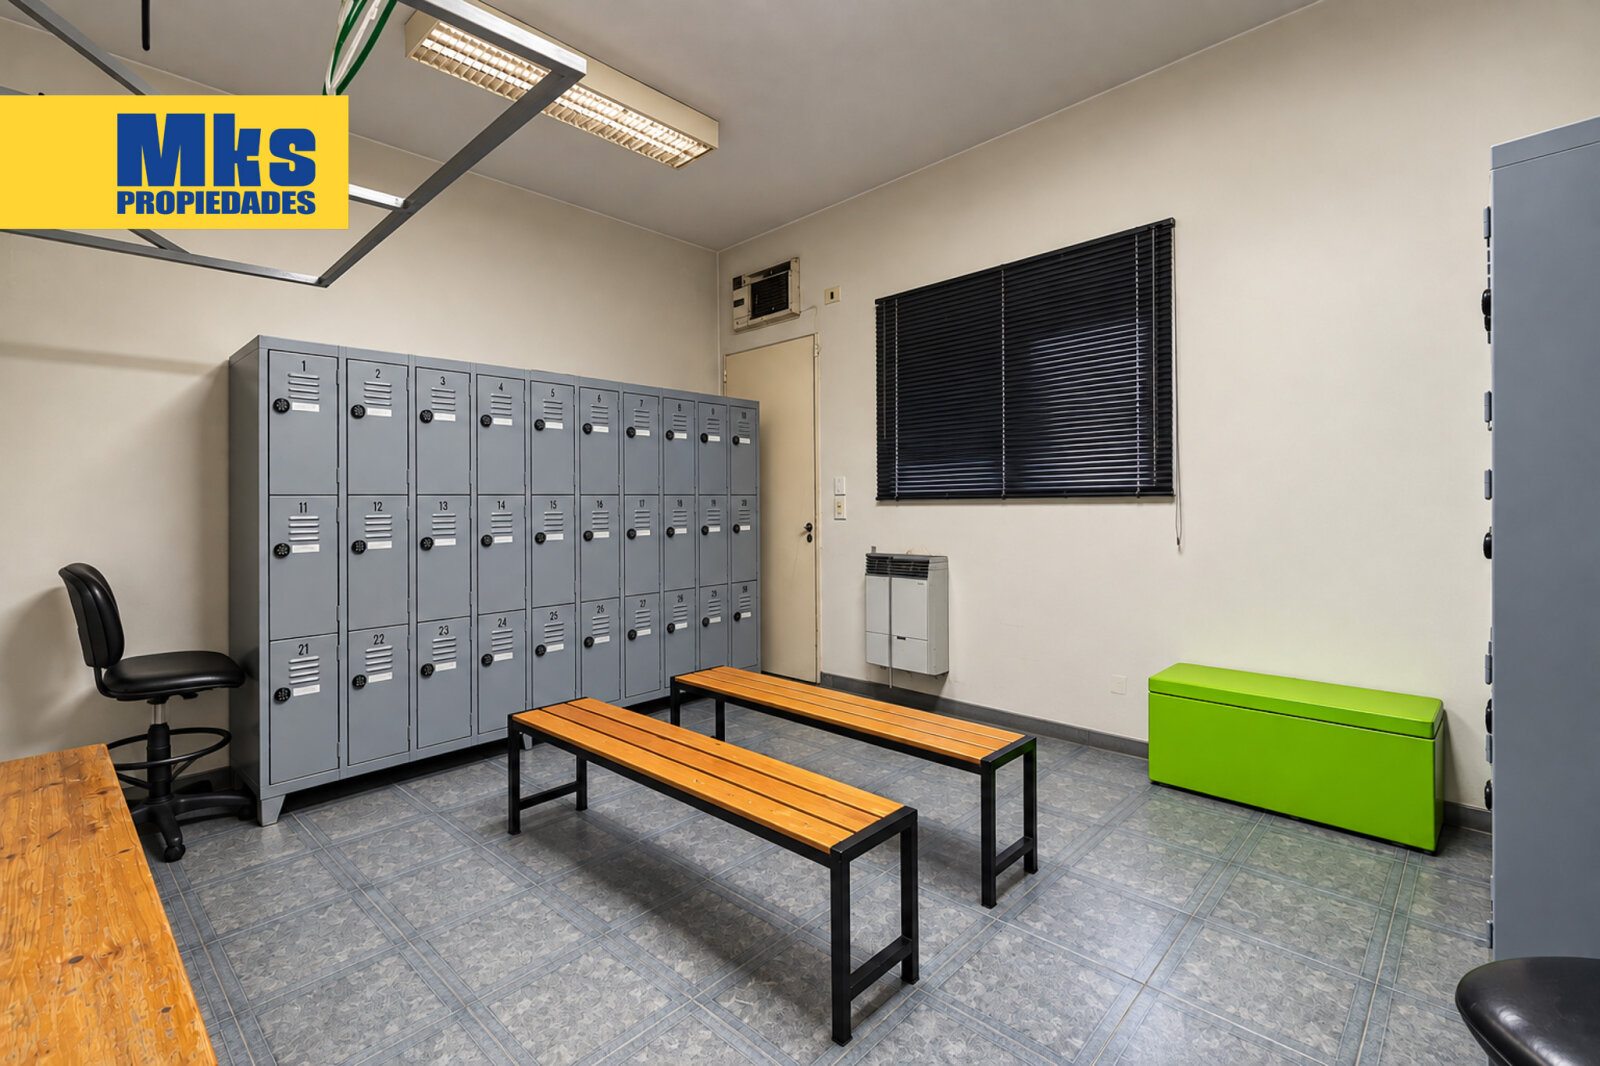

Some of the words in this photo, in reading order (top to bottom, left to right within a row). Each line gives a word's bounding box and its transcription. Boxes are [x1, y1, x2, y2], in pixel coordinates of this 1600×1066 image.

[302, 360, 306, 372] 1
[376, 368, 382, 378] 2
[440, 376, 446, 386] 3
[498, 382, 504, 392] 4
[300, 502, 308, 514] 11
[374, 502, 382, 512] 12
[440, 500, 448, 510] 13
[498, 500, 506, 510] 14
[550, 500, 558, 510] 15
[596, 500, 604, 508] 16
[596, 604, 604, 614] 26
[640, 600, 646, 608] 27
[550, 610, 558, 620] 25
[498, 616, 506, 628] 24
[438, 624, 450, 636] 23
[374, 634, 384, 646] 22
[298, 644, 308, 656] 21
